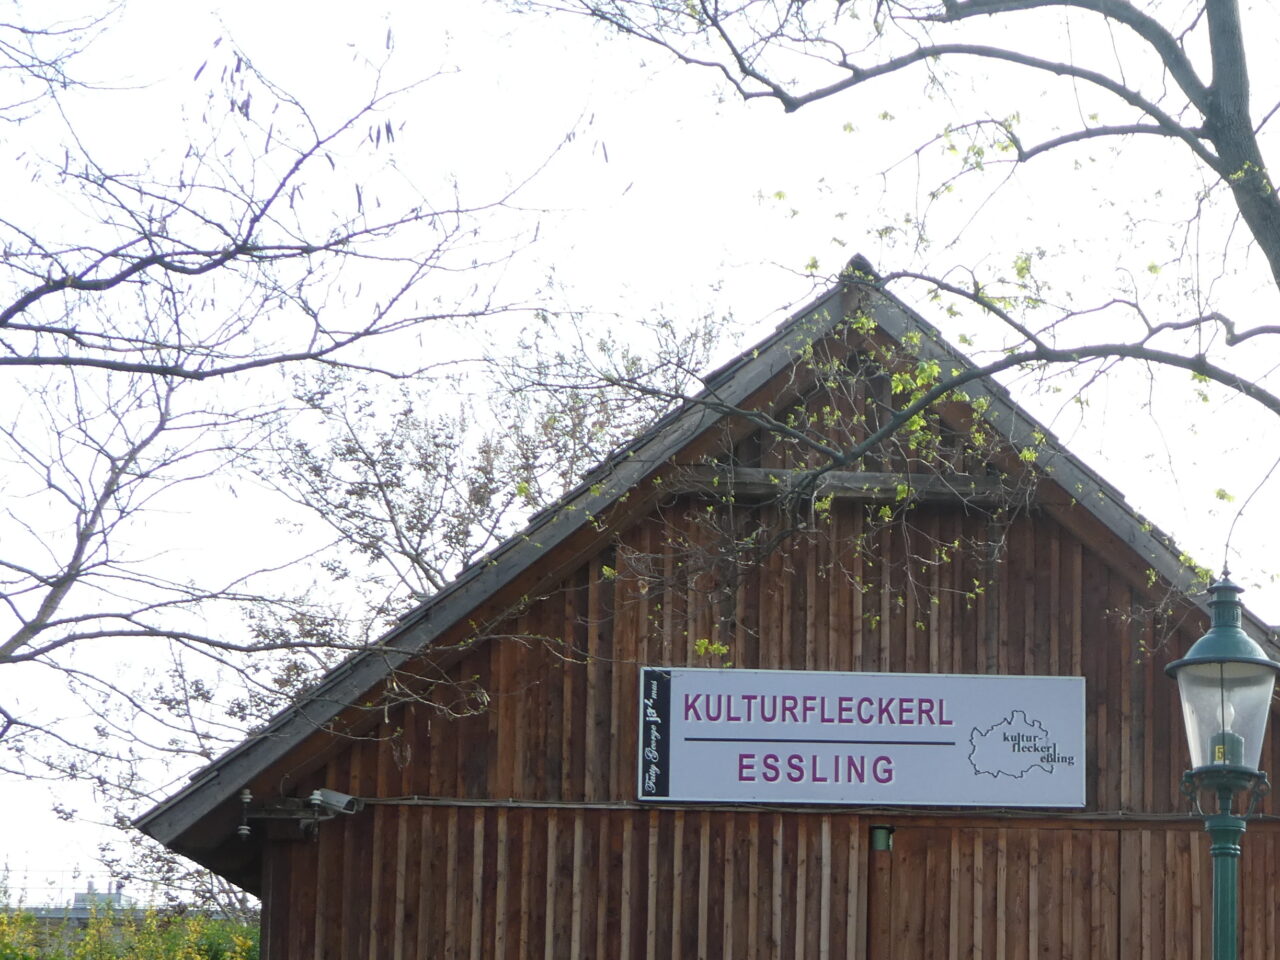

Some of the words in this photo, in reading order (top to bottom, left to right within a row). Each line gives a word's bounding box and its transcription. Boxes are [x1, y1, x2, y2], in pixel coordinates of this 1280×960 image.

[684, 693, 954, 726] KULTURFLECKERL
[645, 724, 661, 762] George
[645, 764, 660, 793] Fatty
[738, 753, 894, 784] ESSLING
